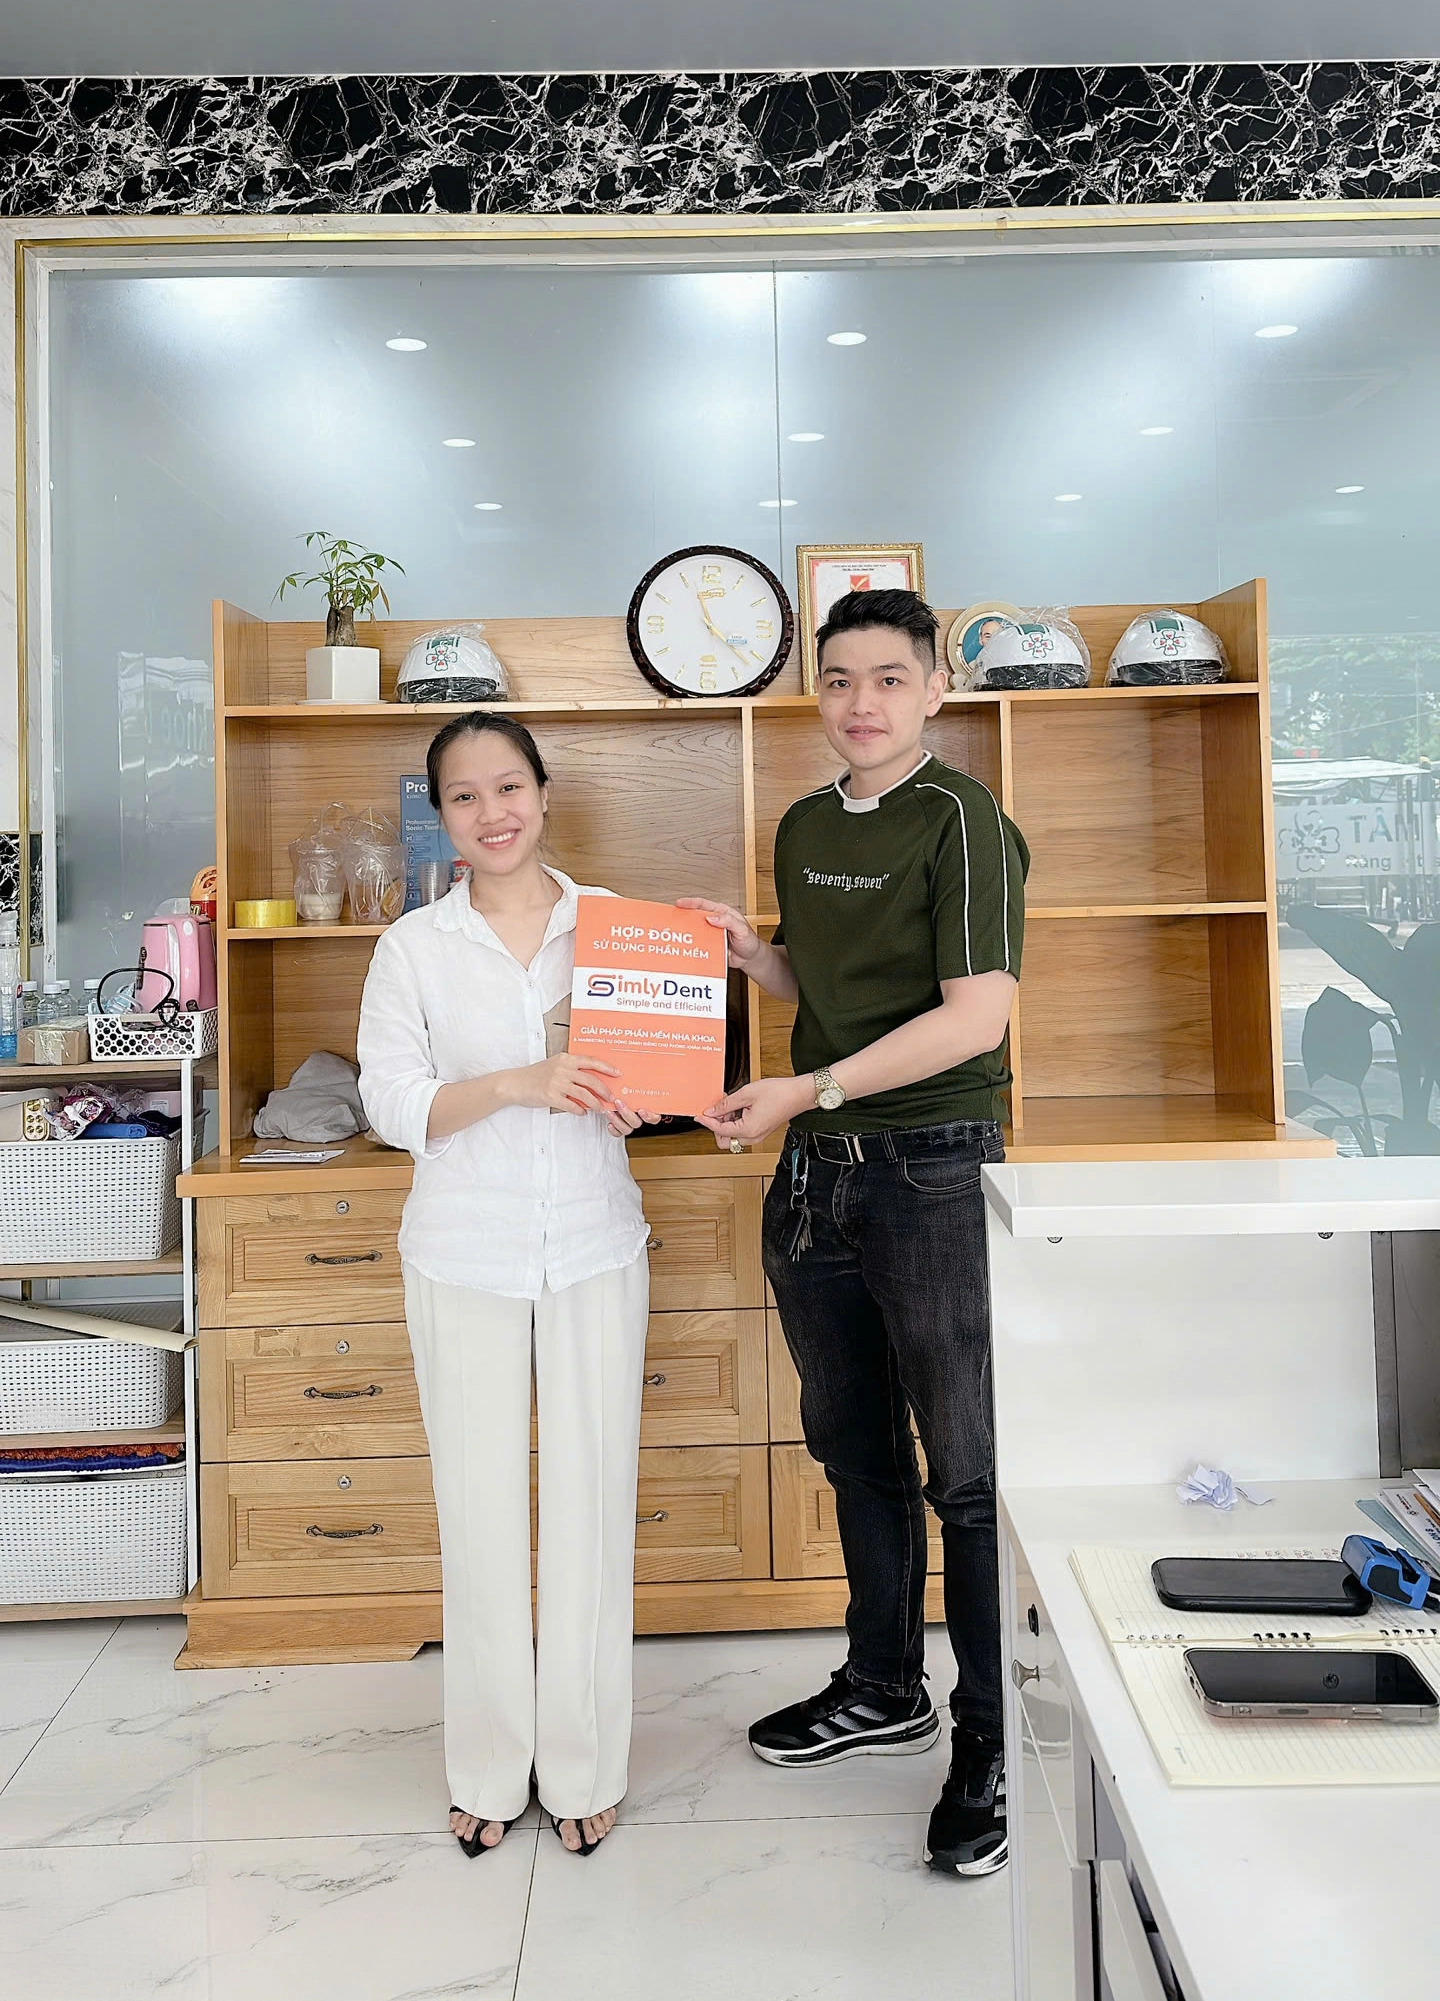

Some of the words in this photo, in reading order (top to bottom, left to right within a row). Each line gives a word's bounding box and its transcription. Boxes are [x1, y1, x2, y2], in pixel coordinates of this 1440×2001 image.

[405, 781, 429, 793] Pro
[611, 925, 644, 941] HỢP
[611, 941, 645, 954] DỤNG
[616, 997, 650, 1009] Simple
[652, 1001, 672, 1009] and
[674, 1001, 713, 1013] Efficient
[671, 1033, 691, 1041] NHA
[691, 1034, 717, 1043] KHOA
